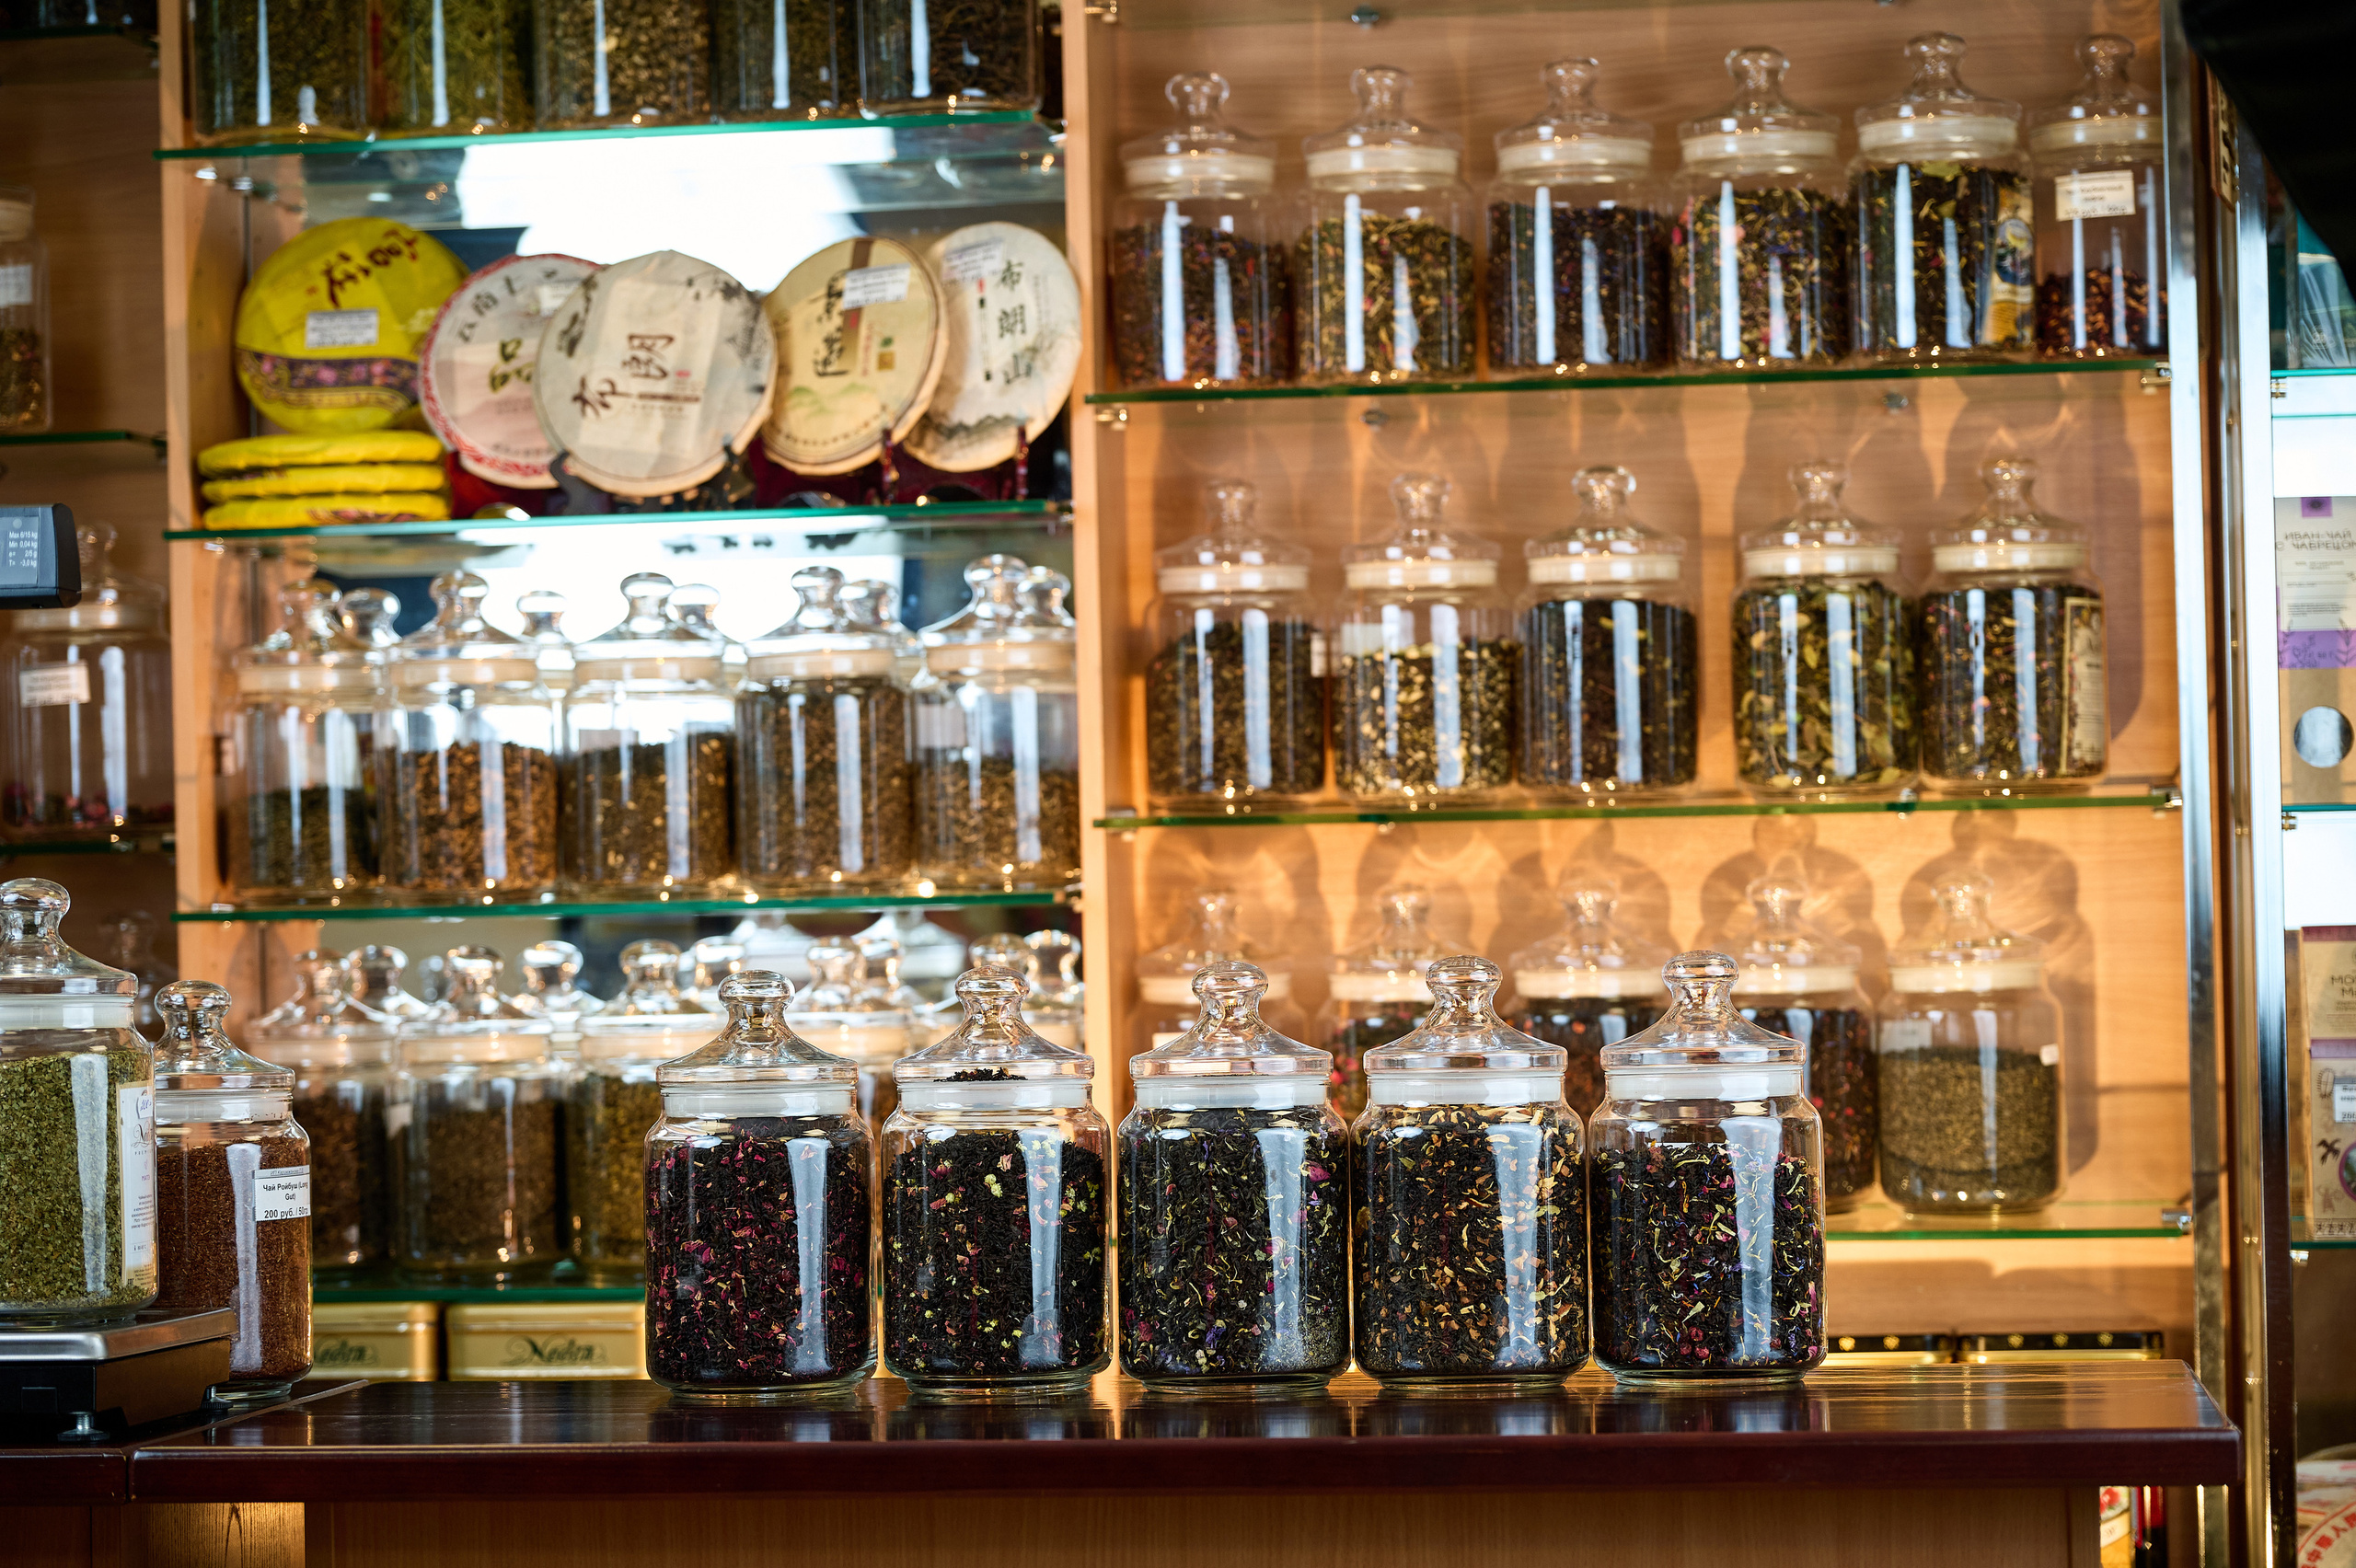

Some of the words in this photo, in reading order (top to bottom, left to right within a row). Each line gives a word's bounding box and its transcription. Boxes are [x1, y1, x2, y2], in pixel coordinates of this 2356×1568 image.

[31, 531, 38, 539] kg
[2284, 528, 2351, 541] ИВАН-ЧАЙ
[31, 540, 38, 549] kg
[30, 559, 37, 568] kg
[2331, 974, 2356, 986] МО
[262, 1183, 276, 1192] Чай
[277, 1182, 297, 1192] Ройбуш
[284, 1193, 296, 1201] Gut)
[264, 1209, 279, 1218] 200
[280, 1207, 294, 1219] руб.
